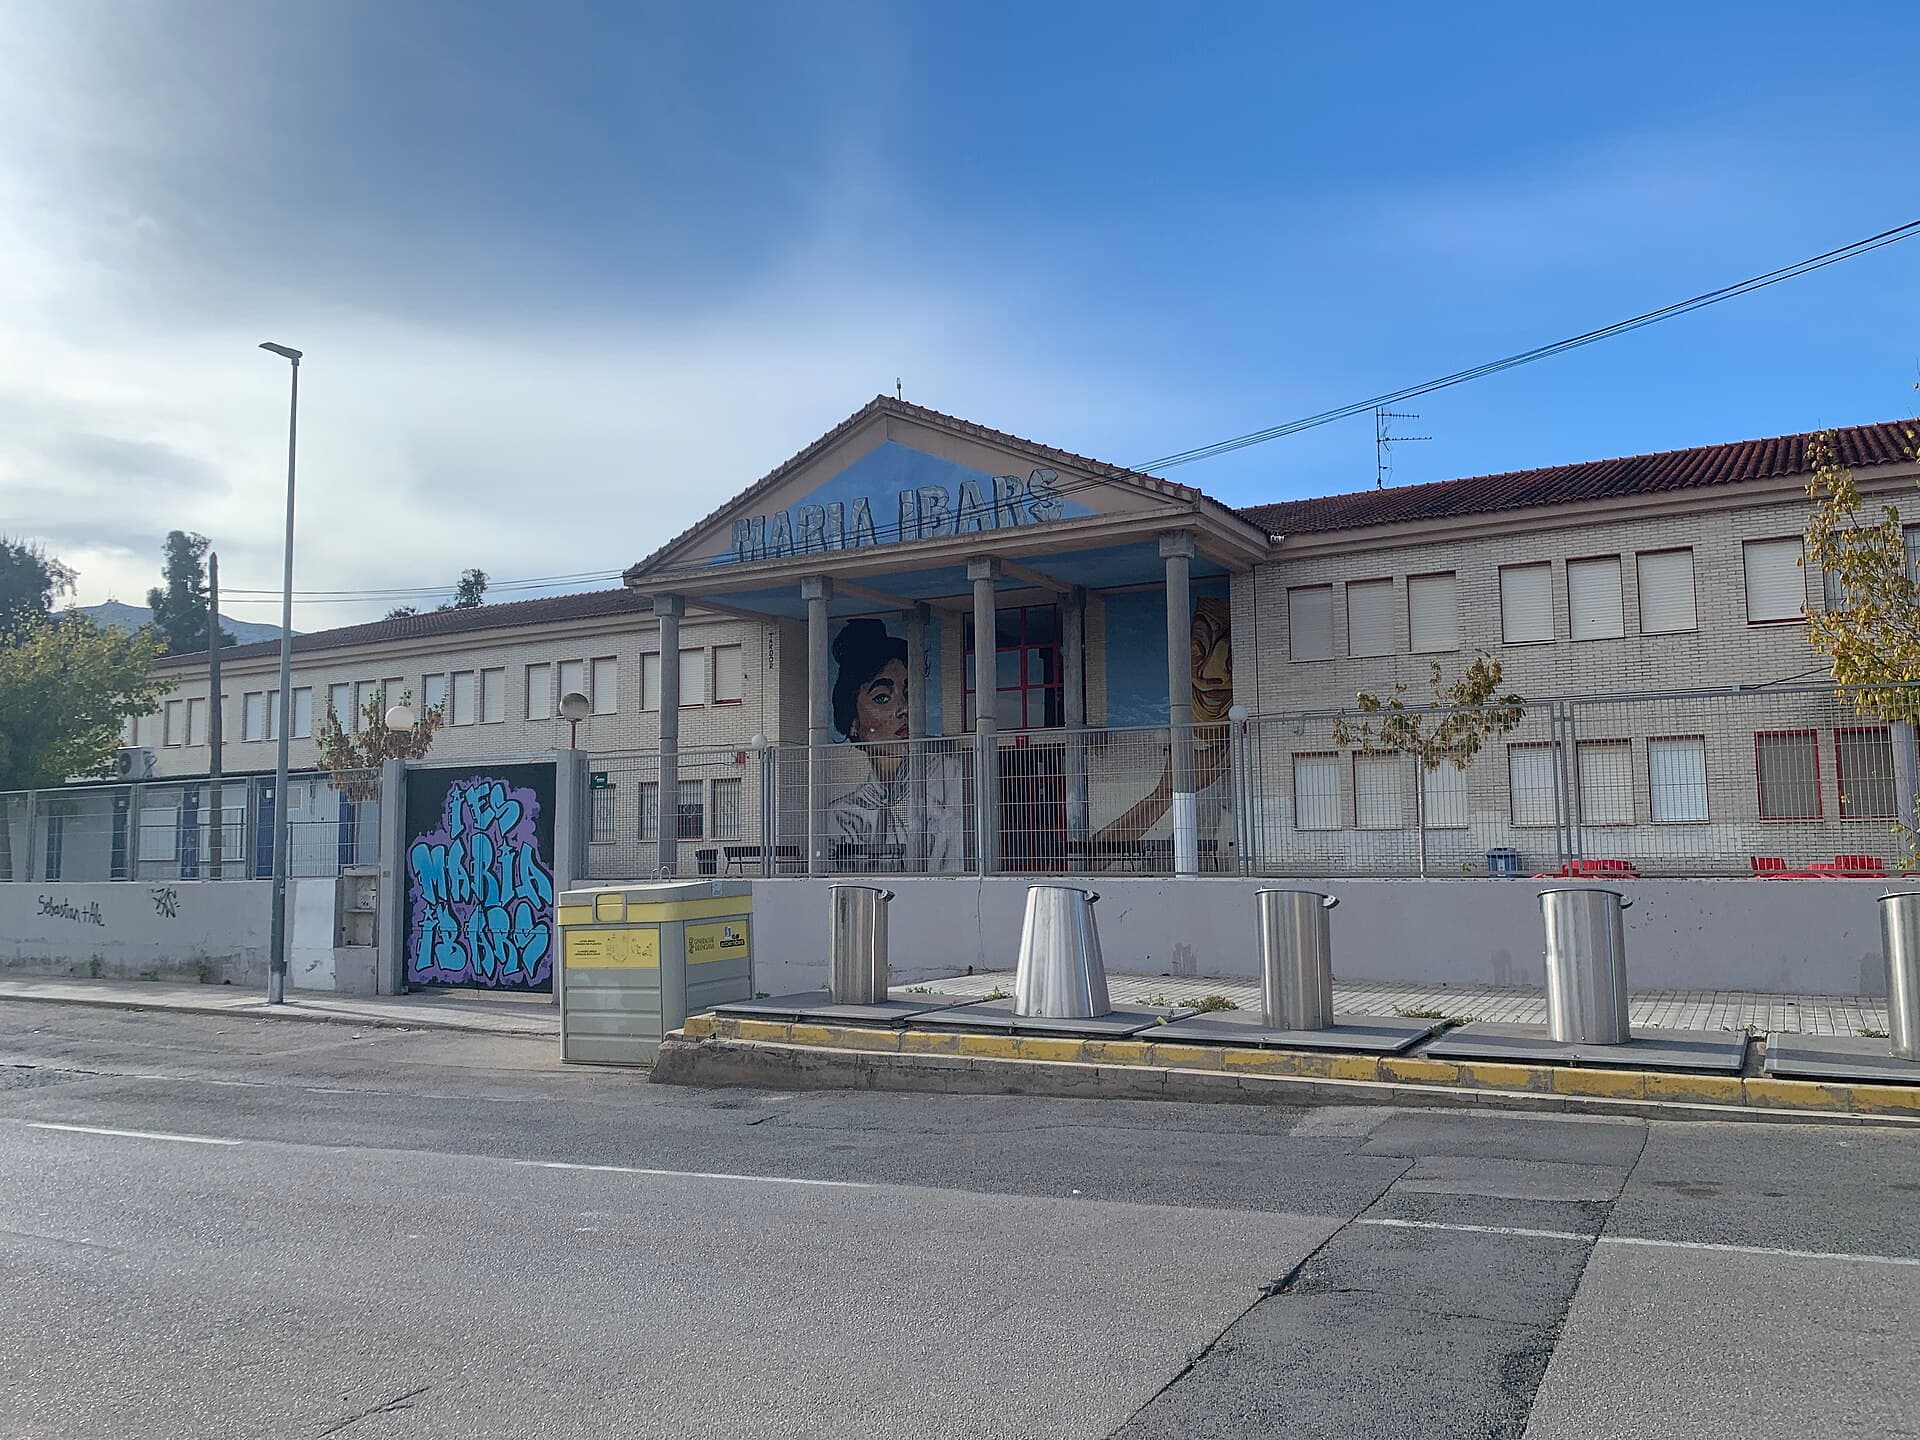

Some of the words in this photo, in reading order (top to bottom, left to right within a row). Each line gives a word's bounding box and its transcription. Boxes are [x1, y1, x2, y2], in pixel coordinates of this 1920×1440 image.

[732, 496, 877, 563] MARIA
[898, 468, 1064, 543] IBARS
[411, 832, 553, 911] MARIA
[416, 902, 549, 978] IBARS
